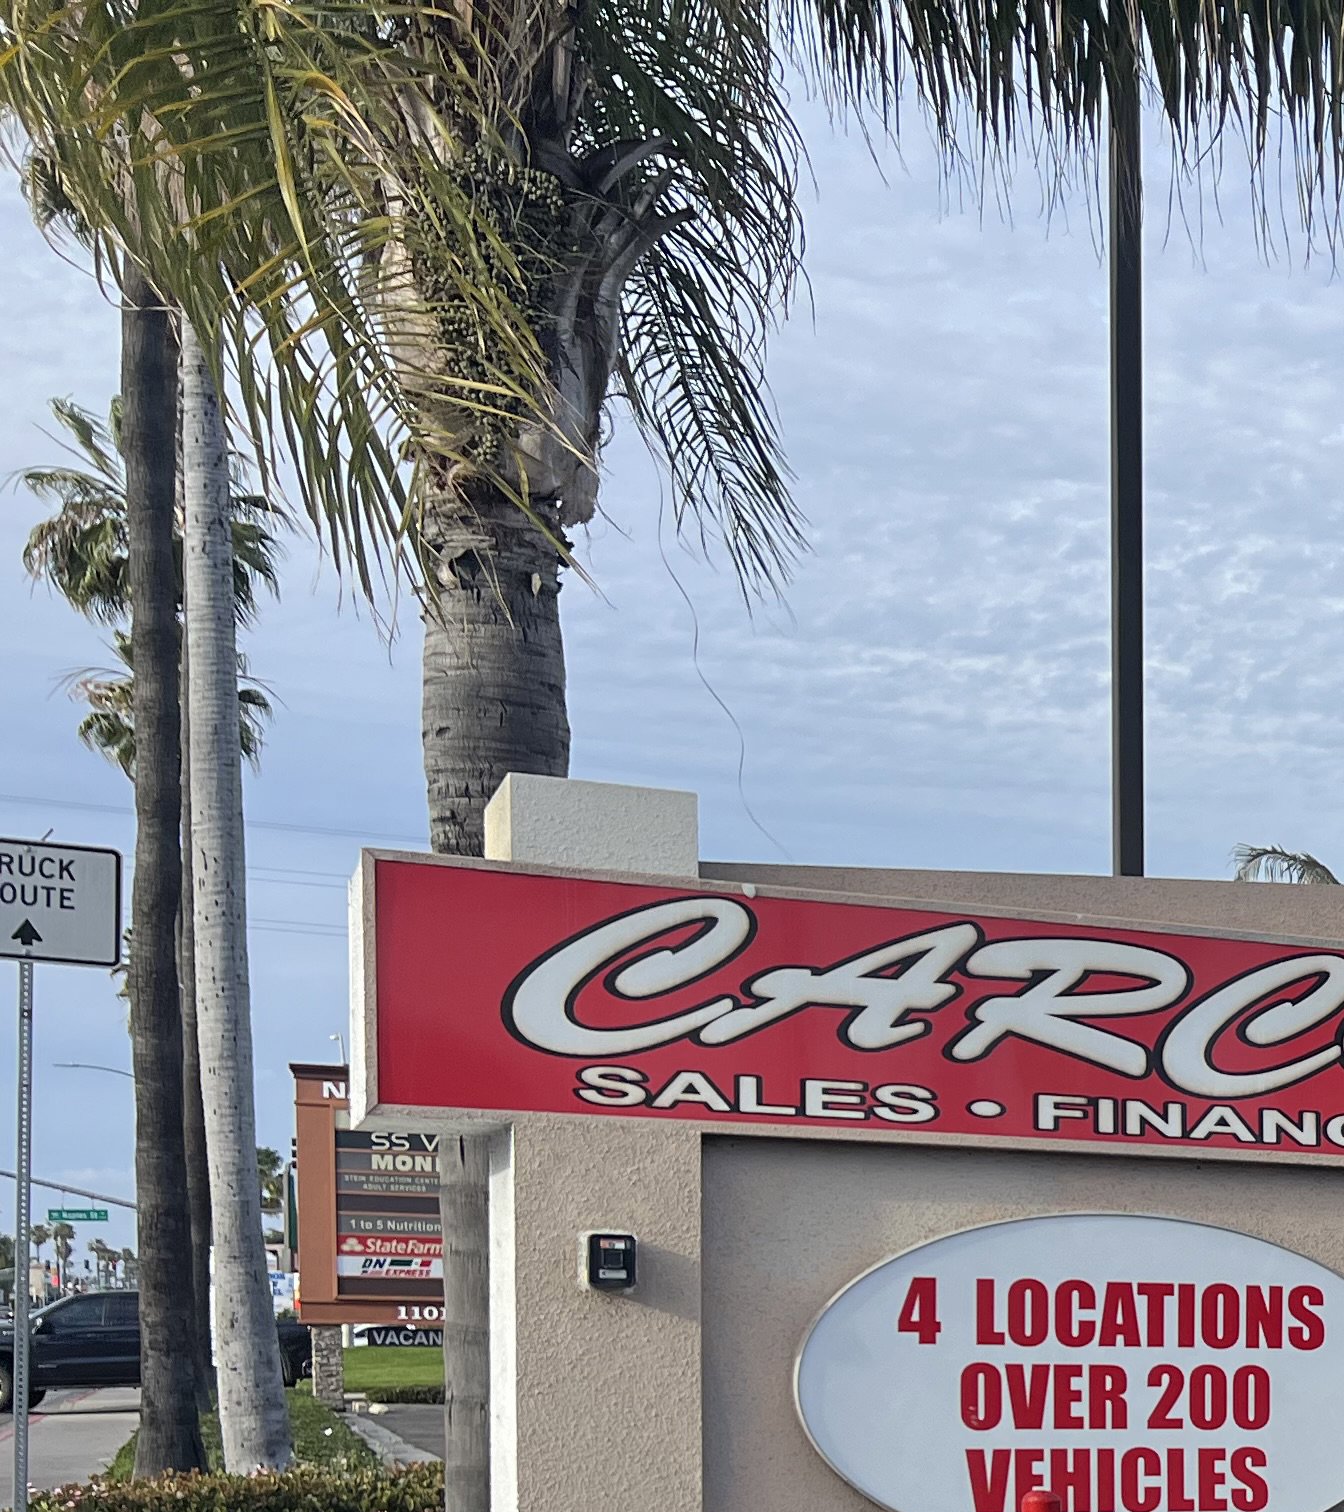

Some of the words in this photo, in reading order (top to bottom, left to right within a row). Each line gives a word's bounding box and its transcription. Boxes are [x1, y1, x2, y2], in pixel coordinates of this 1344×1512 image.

[0, 853, 76, 882] RUCK
[0, 882, 75, 910] OUTE
[322, 1081, 349, 1099] N
[573, 1064, 941, 1124] SALES
[371, 1132, 410, 1151] SS
[420, 1133, 438, 1152] V
[371, 1154, 438, 1172] MON
[369, 1175, 412, 1184] EDUCATION
[389, 1184, 427, 1192] SERVICES
[350, 1219, 356, 1229] 1
[361, 1219, 373, 1230] to
[376, 1220, 383, 1230] 5
[387, 1220, 442, 1232] Nutrition
[897, 1277, 942, 1344] 4
[976, 1278, 1326, 1351] LOCATIONS
[372, 1330, 443, 1345] VACAN
[960, 1362, 1128, 1431] OVER
[1147, 1363, 1271, 1431] 200
